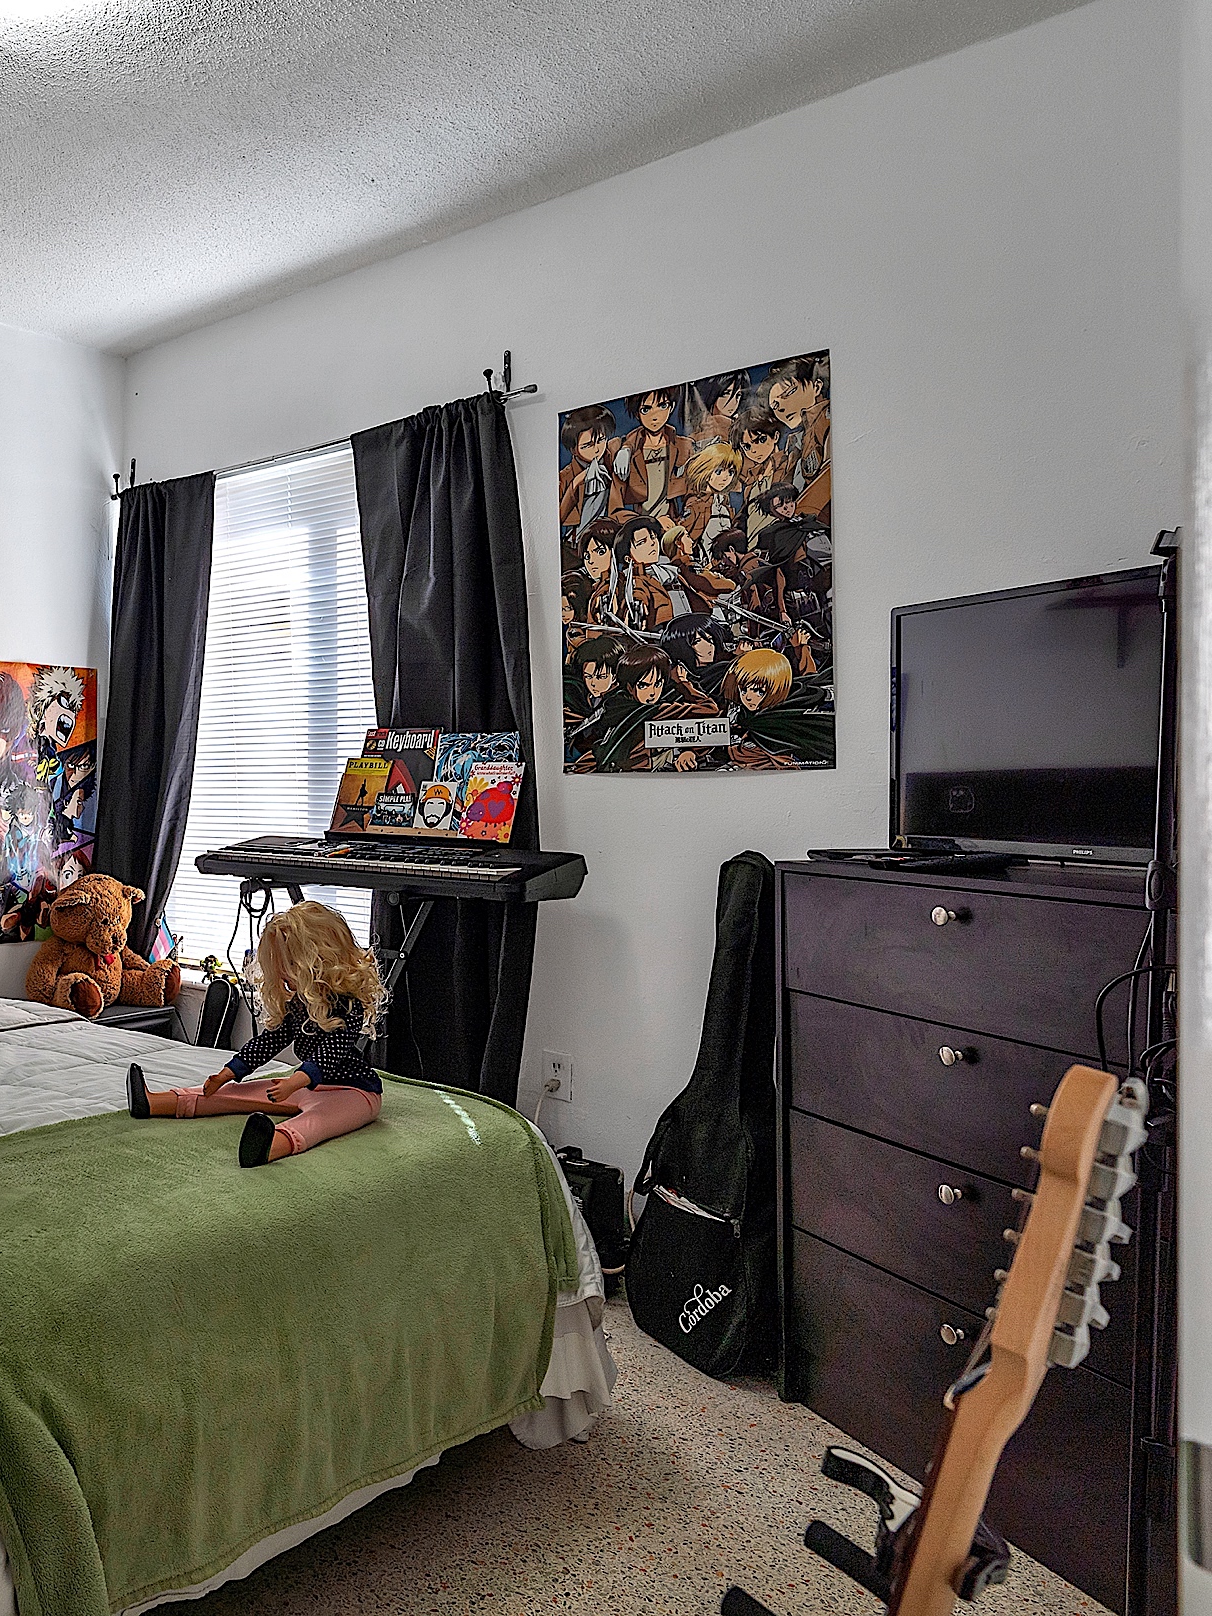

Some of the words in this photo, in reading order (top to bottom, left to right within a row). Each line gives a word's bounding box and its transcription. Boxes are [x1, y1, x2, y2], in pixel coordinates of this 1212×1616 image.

[648, 723, 683, 738] Attack
[685, 726, 694, 734] on
[695, 721, 728, 736] Titan
[385, 729, 435, 753] Keyboard
[348, 761, 389, 769] PLAYBILL
[379, 795, 399, 803] SIMPLE
